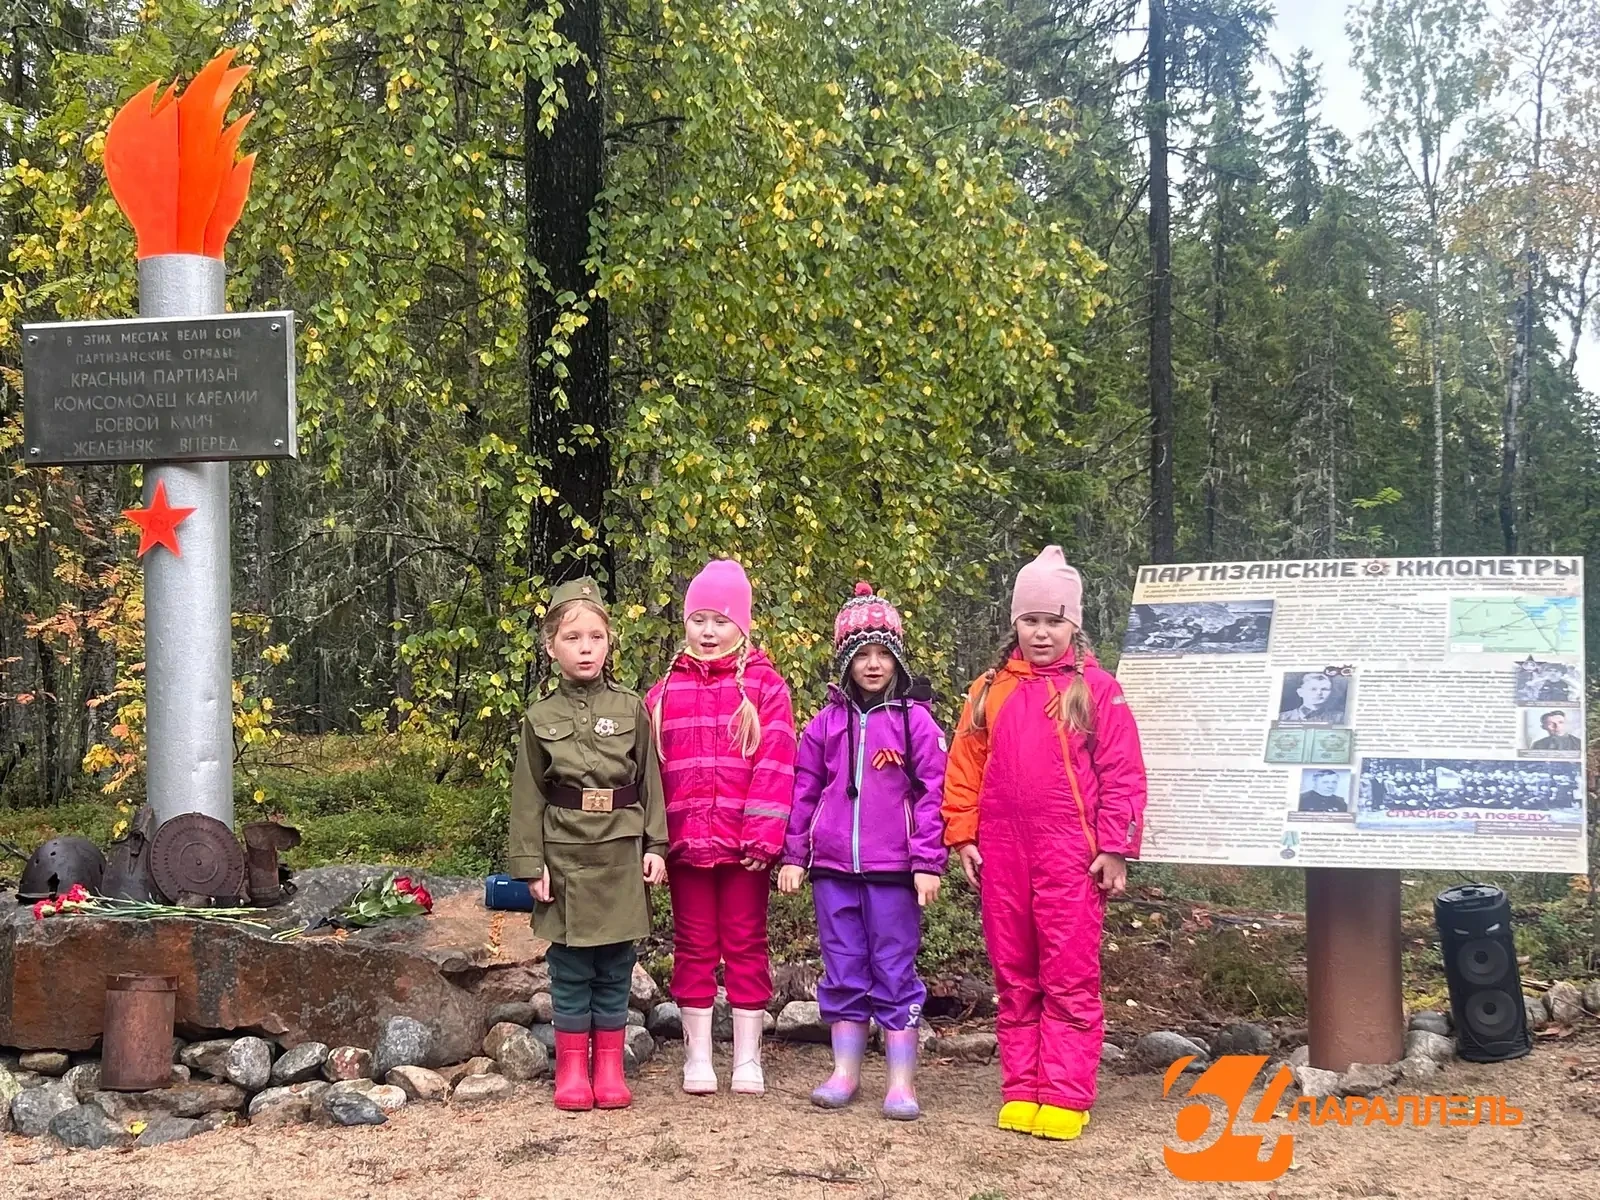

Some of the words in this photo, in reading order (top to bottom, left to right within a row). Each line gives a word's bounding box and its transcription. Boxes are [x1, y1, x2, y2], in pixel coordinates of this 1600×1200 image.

[66, 335, 73, 347] В
[83, 334, 112, 346] ЭТИХ
[121, 331, 168, 344] МЕСТАХ
[177, 329, 207, 342] ВЕЛИ
[215, 327, 241, 340] БОИ
[76, 350, 172, 365] ПАРТИЗАНСКИЕ
[183, 348, 232, 361] ОТРЯДЫ
[71, 371, 145, 388] КРАСНЫЙ
[153, 367, 238, 385] ПАРТИЗАН
[54, 393, 177, 412] КОМСОМОЛЕЦ
[186, 390, 258, 406] КАРЕЛИИ
[96, 416, 159, 433] БОЕВОЙ
[171, 415, 213, 430] КЛИЧ
[73, 439, 153, 456] ЖЕЛЕЗНЯК
[180, 436, 240, 452] ВПЕРЕД
[1138, 562, 1358, 583] ПАРТИЗАНСКИЕ
[1396, 559, 1579, 577] КИЛОМЕТРЫ
[1386, 810, 1458, 819] СПАСИБО
[1461, 812, 1481, 820] ЗА
[1485, 812, 1552, 821] ПОБЕДУ!
